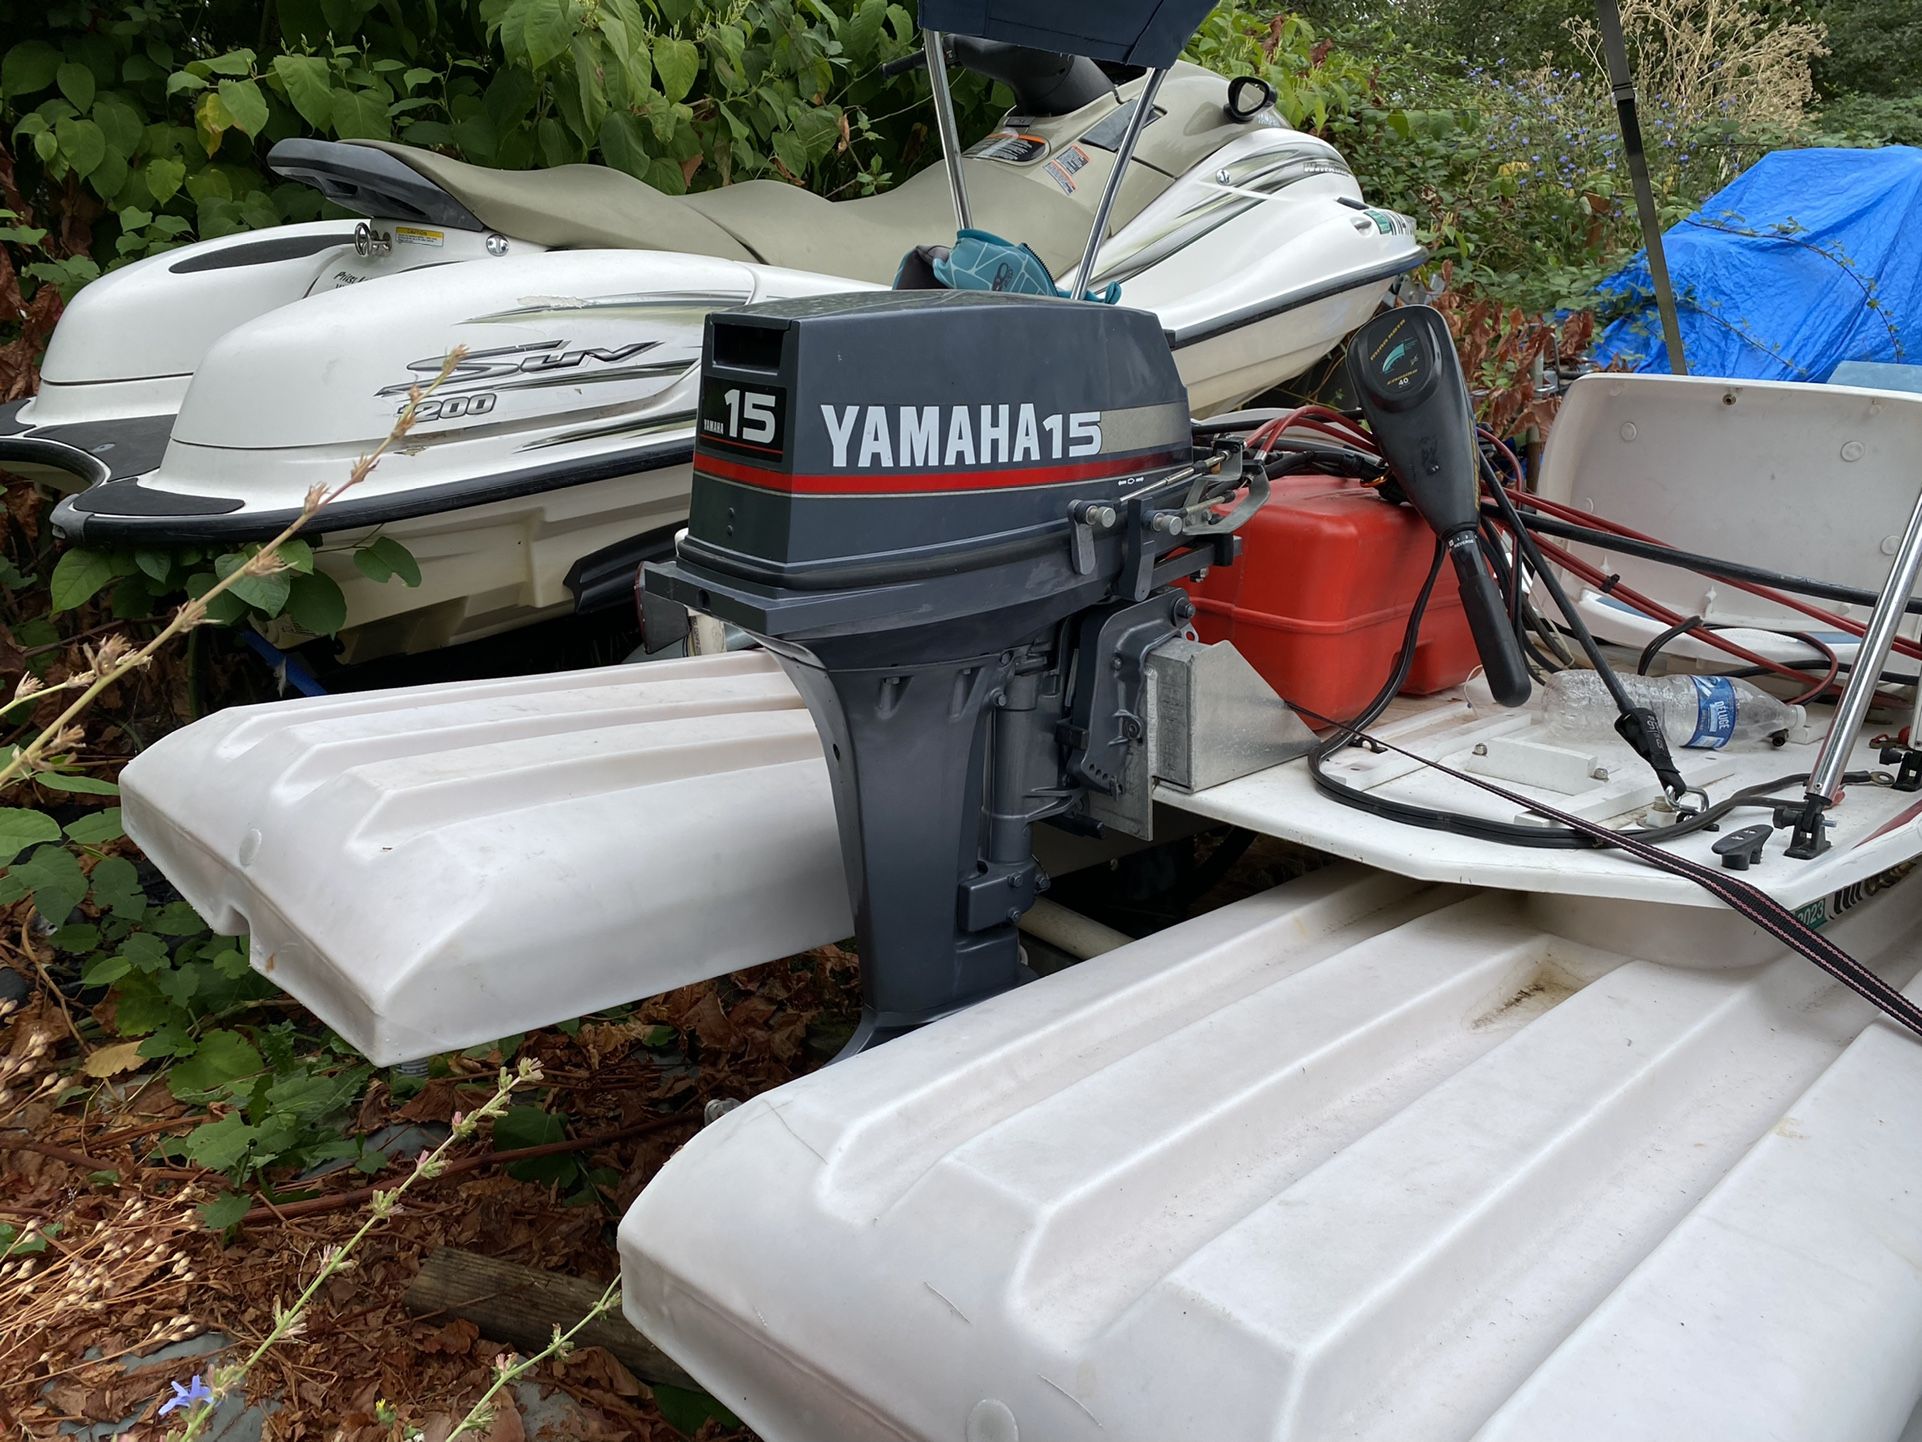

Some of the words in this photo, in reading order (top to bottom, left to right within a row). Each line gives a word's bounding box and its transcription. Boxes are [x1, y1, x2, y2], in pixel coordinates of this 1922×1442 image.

[1398, 377, 1409, 386] 40
[703, 418, 724, 435] YAMAHA
[724, 388, 776, 444] 15
[820, 403, 1041, 468] YAMAHA
[1042, 411, 1102, 459] 15
